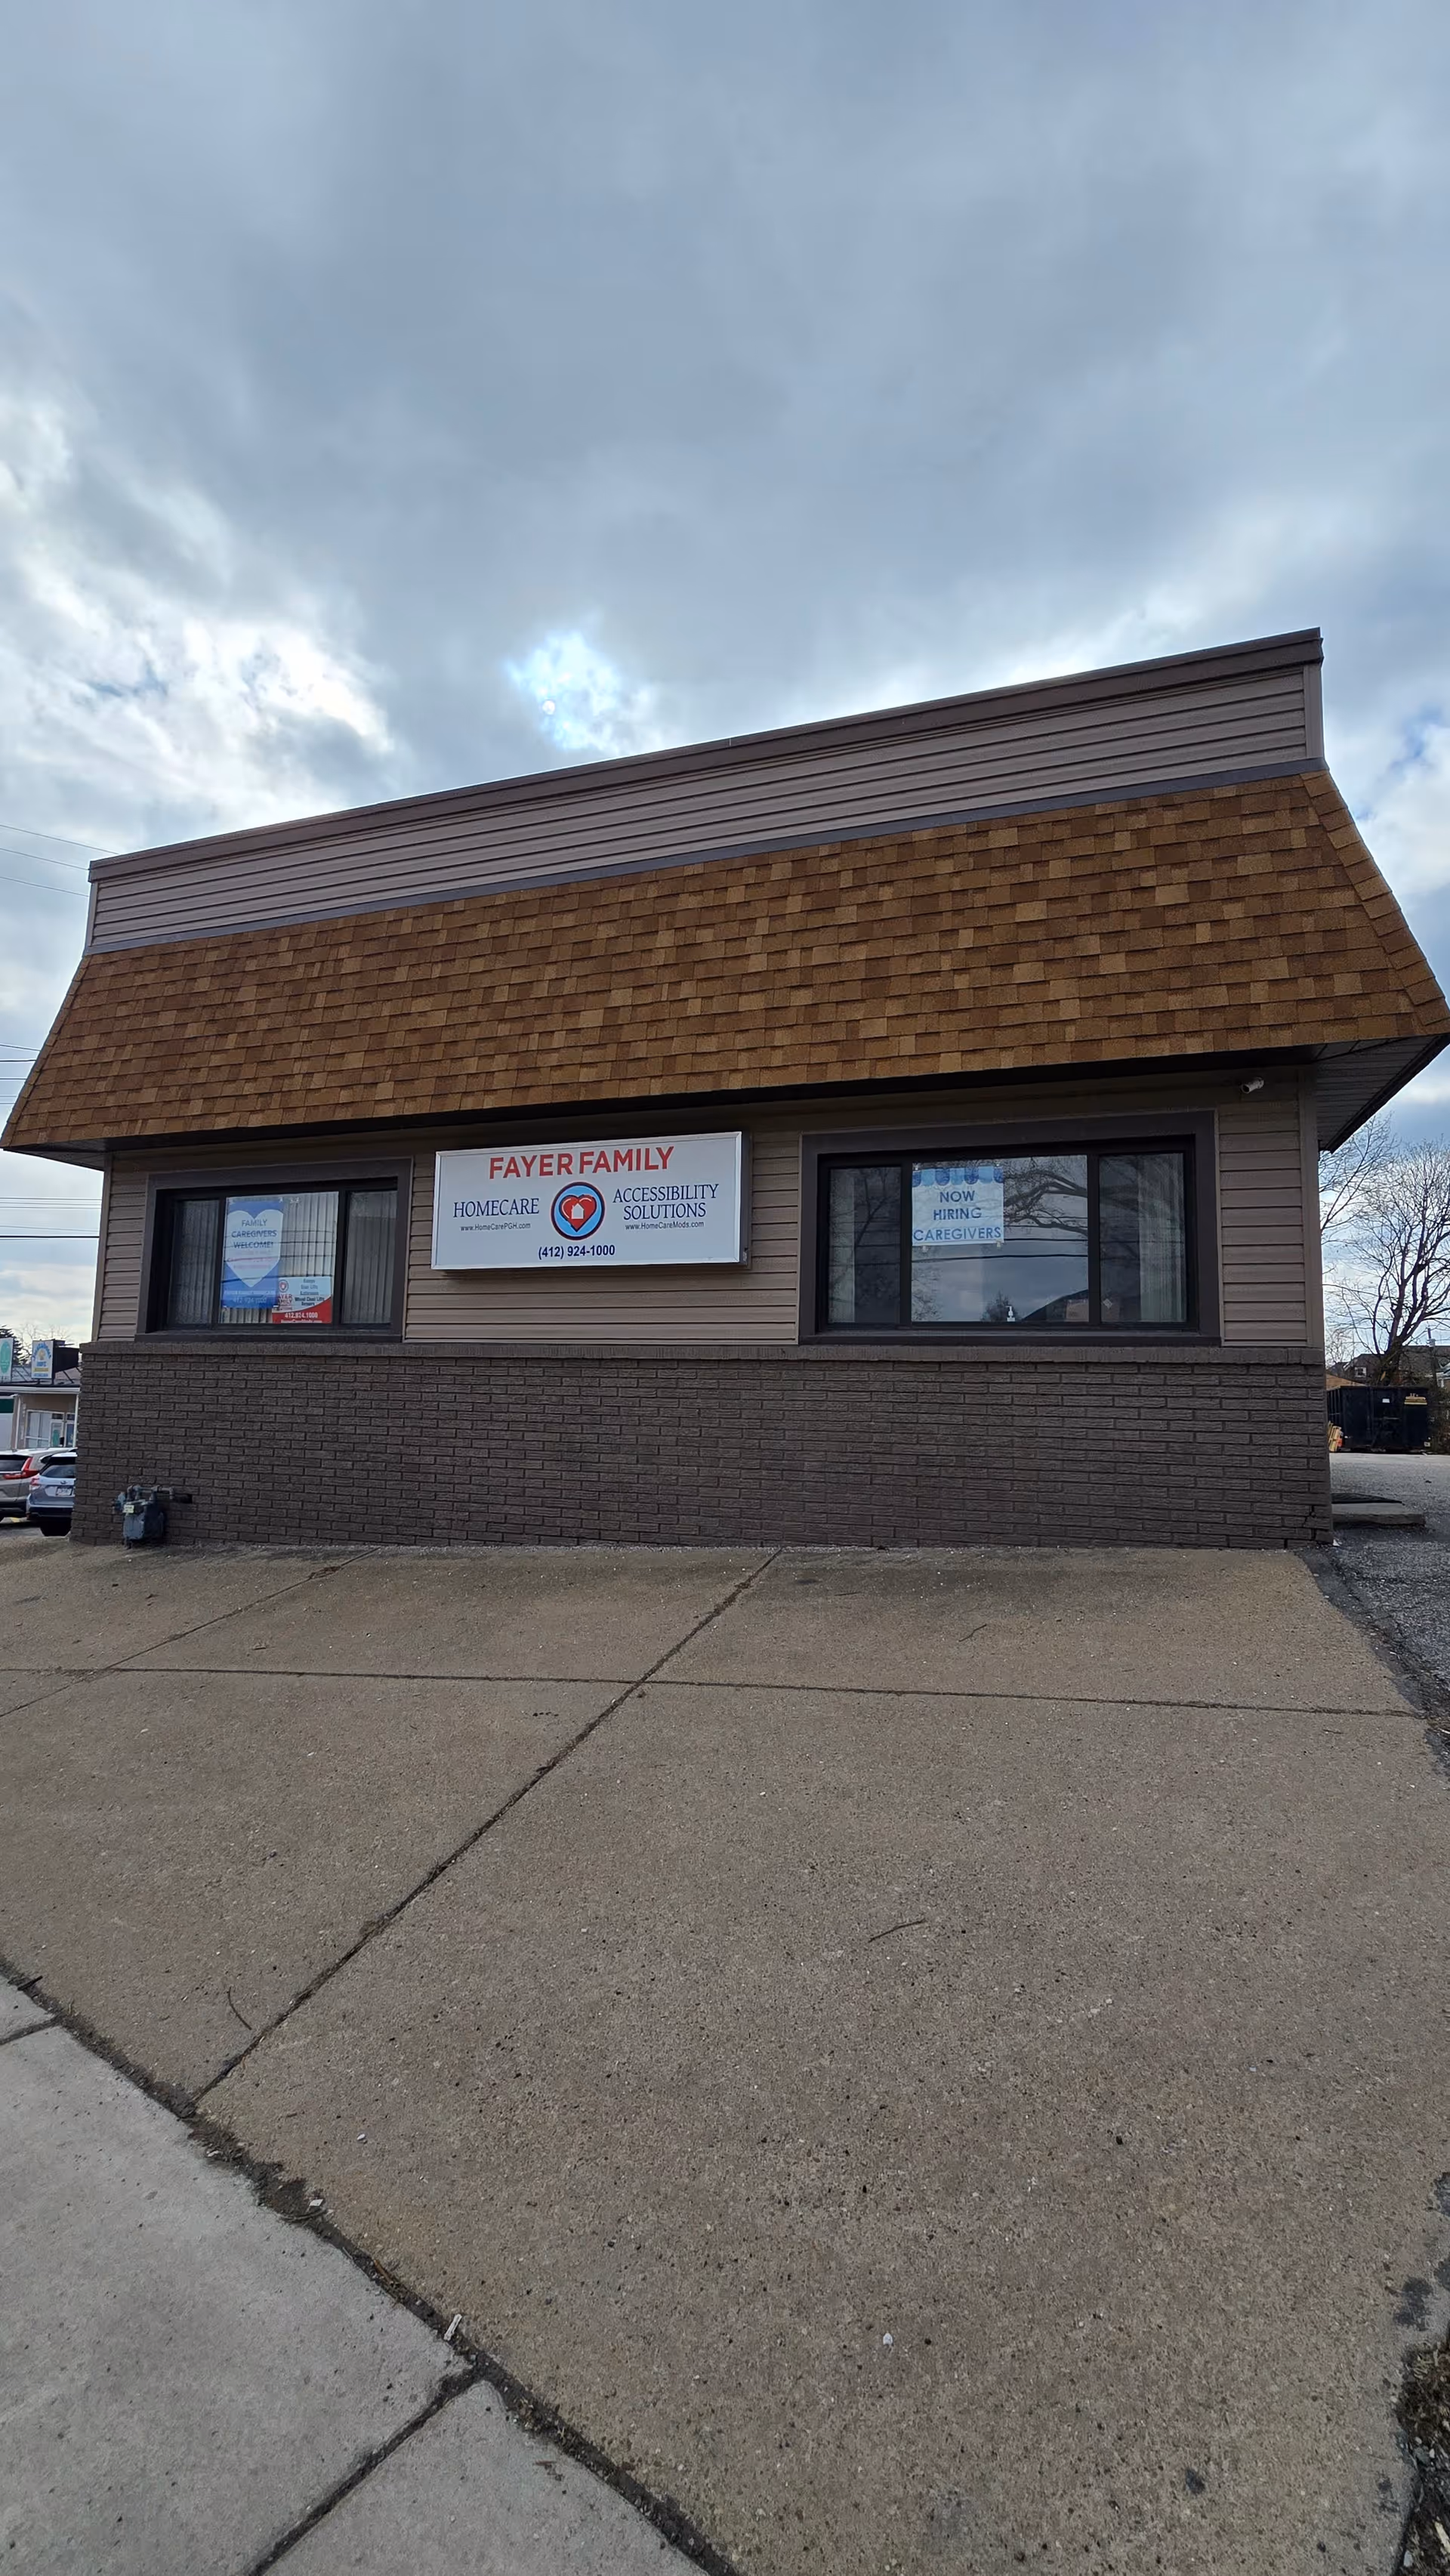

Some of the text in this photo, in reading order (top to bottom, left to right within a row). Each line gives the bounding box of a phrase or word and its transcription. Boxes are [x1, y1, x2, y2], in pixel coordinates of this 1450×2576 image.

[489, 1146, 674, 1179] FAYER FAMILY
[612, 1184, 719, 1203] ACCESSIBILITY
[939, 1190, 976, 1203] NOW
[453, 1198, 540, 1218] HOMECARE
[623, 1203, 706, 1220] SOLUTIONS
[933, 1207, 982, 1220] HIRING
[241, 1219, 267, 1227] FAMILY
[460, 1222, 531, 1231] www.HomeCarePGH.com
[625, 1221, 704, 1230] www.HomeCareMods.com
[913, 1227, 1001, 1241] CAREGIVERS
[233, 1240, 273, 1249] WELCOME!
[538, 1244, 615, 1260] (412) 924-1000
